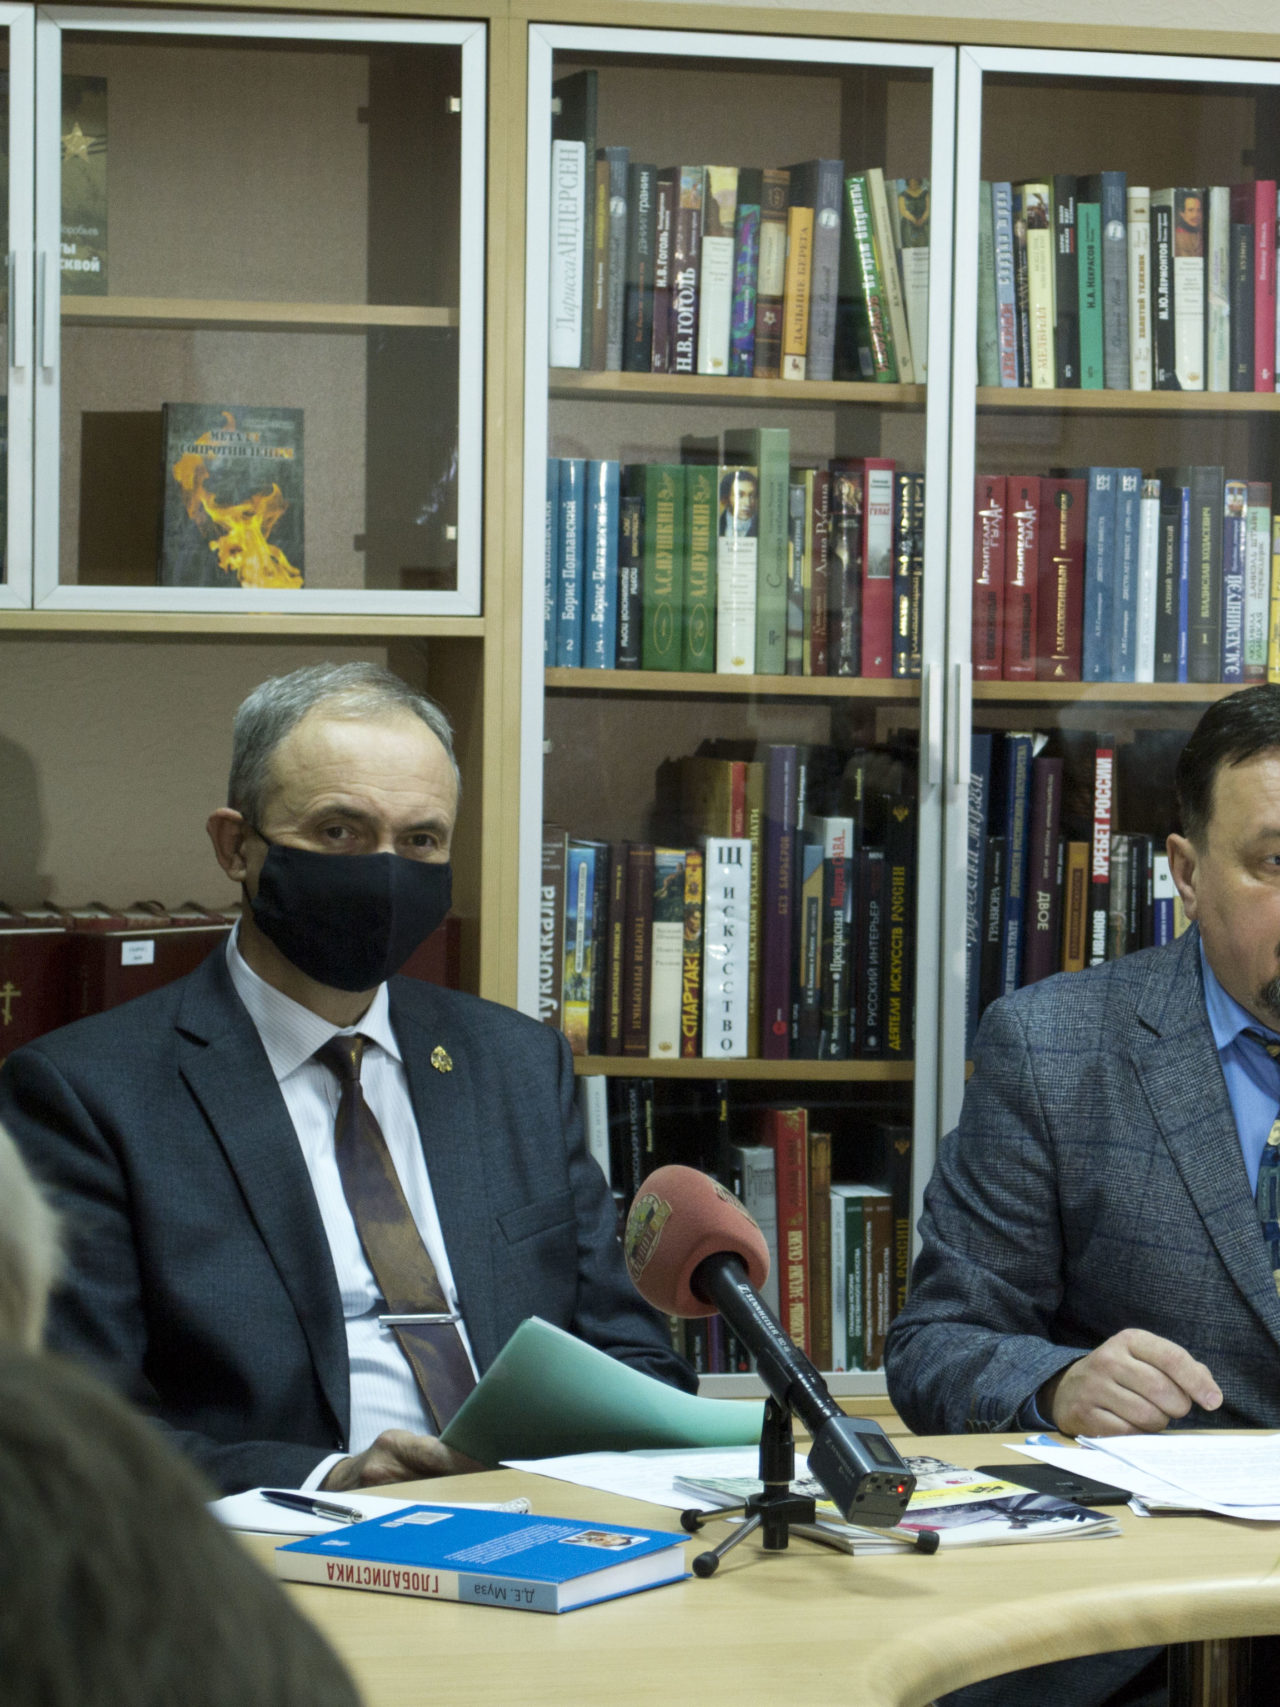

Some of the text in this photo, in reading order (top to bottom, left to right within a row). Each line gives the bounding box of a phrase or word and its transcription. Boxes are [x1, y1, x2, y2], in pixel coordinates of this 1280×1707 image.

[558, 147, 580, 260] АНДЕРСЕН
[795, 226, 808, 275] БЕРЕГА
[677, 267, 696, 335] ГОГОЛЬ
[562, 500, 577, 579] Поплавский
[815, 483, 833, 535] Рубина
[976, 518, 991, 585] АРХИПЕЛАГ
[1010, 520, 1026, 587] АРХИПЕЛАГ
[1200, 506, 1212, 618] ВЛАДИСЛАВ ХОДАСЕВИЧ
[562, 582, 578, 620] Борис
[1226, 574, 1242, 650] ХЕМИНГУЭЙ
[717, 845, 742, 867] Щ
[1092, 757, 1113, 957] ИВАНОВ ХРЕБЕТ РОССИИ
[829, 910, 846, 972] Прекрасная
[987, 887, 1001, 942] ГРАВЮРА
[1036, 891, 1051, 931] ДВОЕ
[719, 886, 736, 1051] ИСКУССТВО
[867, 900, 880, 1027] РУССКИЙ ИНТЕРЬЕР
[888, 865, 905, 1051] ДЕЯТЕЛИ ИСКУССТВ РОССИИ
[682, 956, 700, 1038] СПАРТАК
[895, 1218, 909, 1278] РОССИИ
[745, 1292, 780, 1336] SENNHEISER
[325, 1562, 440, 1594] ГЛОБАЛИСТИКА
[473, 1583, 535, 1605] Д.Е. Муза
